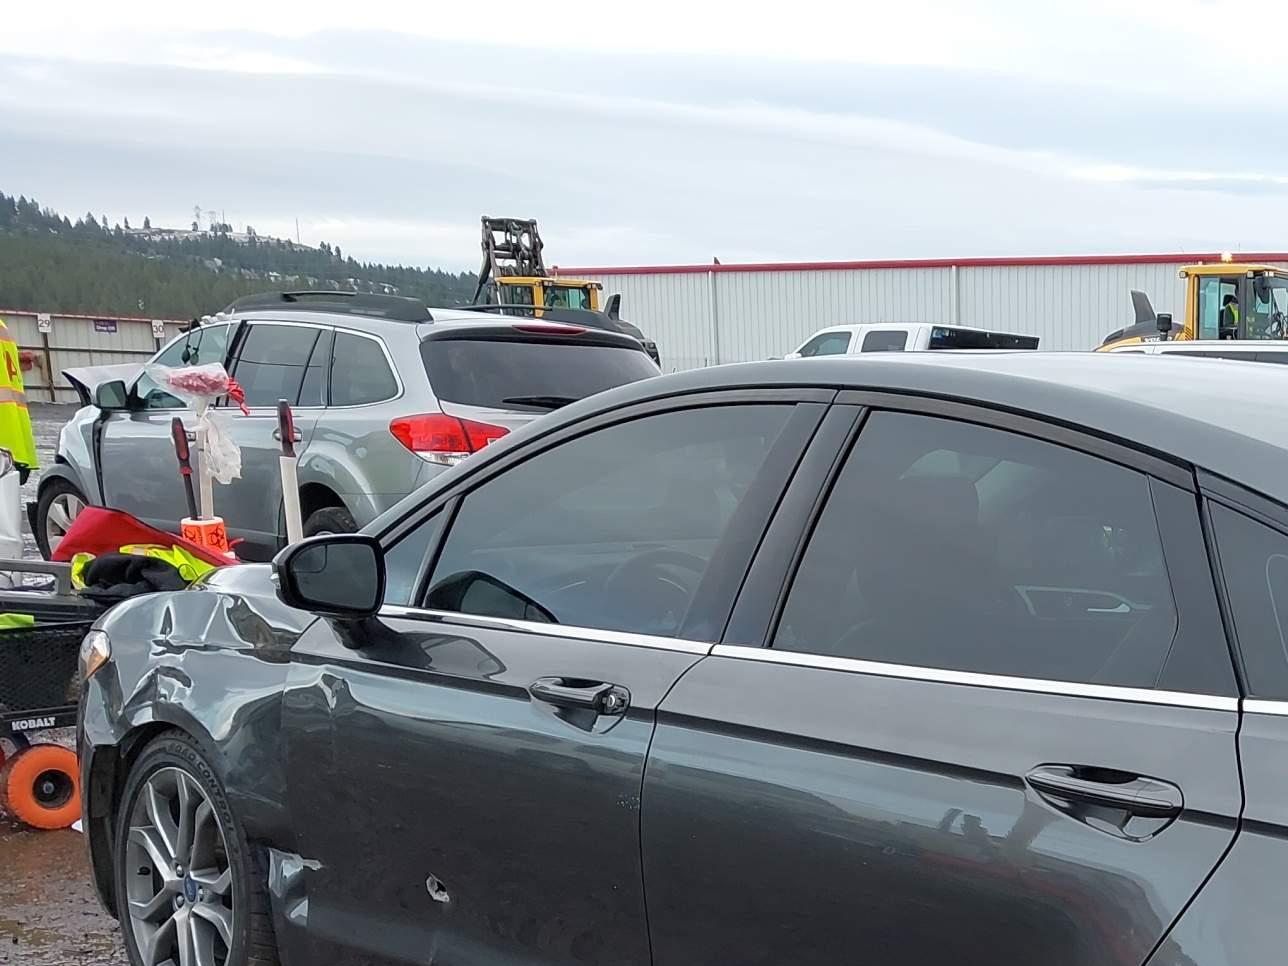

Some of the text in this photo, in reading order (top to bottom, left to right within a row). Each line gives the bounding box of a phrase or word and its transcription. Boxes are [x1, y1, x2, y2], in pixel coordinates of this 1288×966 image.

[38, 319, 50, 328] 29
[152, 324, 165, 334] 30
[11, 716, 56, 731] KOBALT
